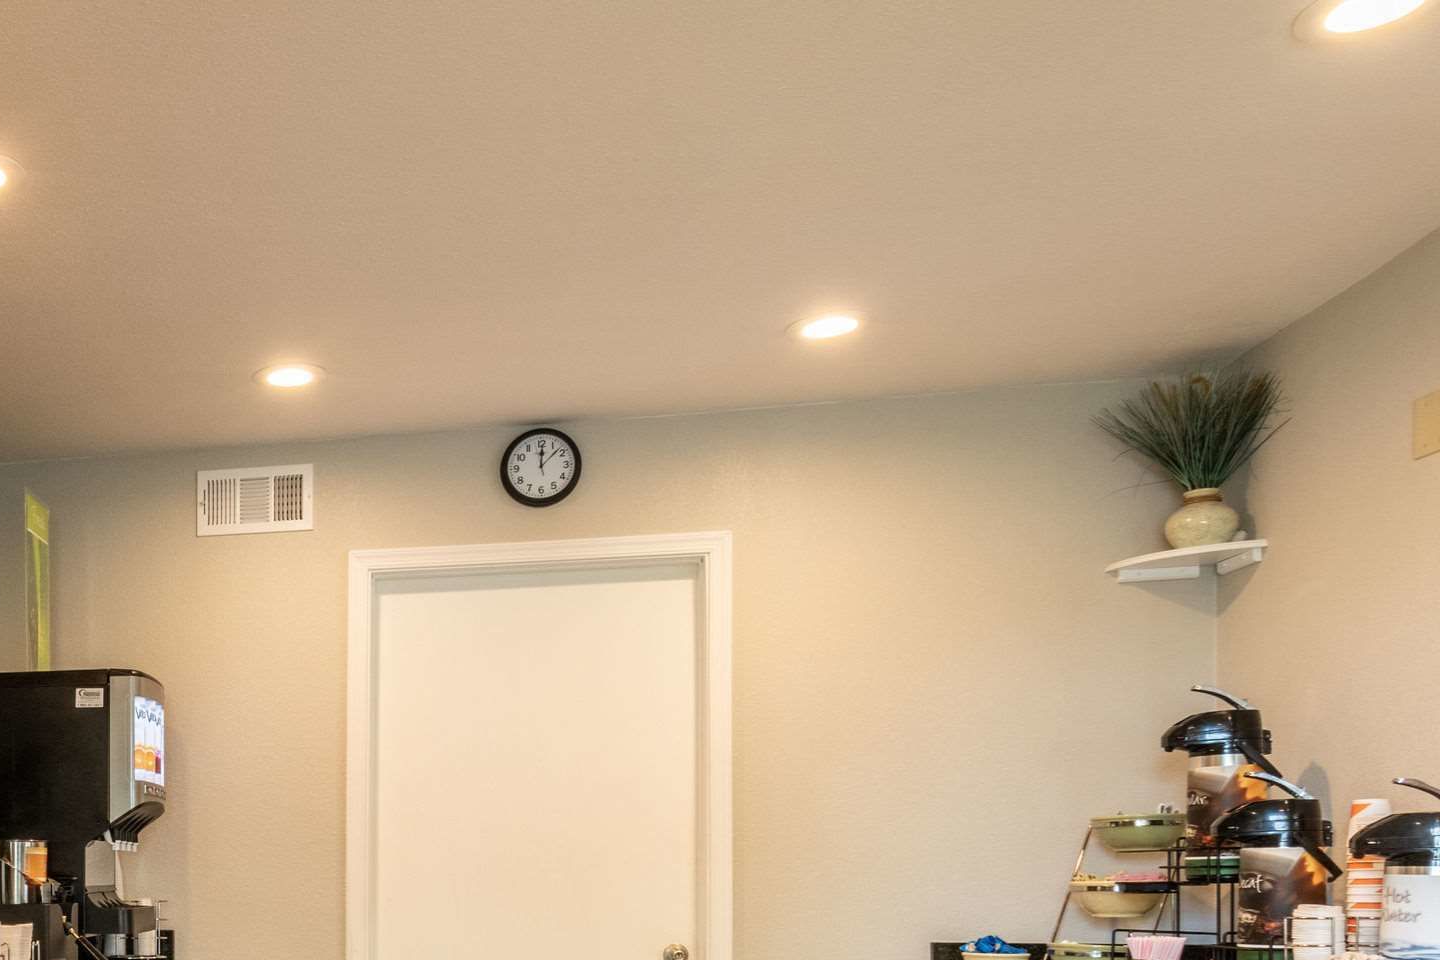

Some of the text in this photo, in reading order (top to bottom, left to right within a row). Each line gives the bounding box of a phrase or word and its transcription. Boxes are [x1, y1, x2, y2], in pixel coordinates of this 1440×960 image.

[526, 444, 531, 453] 11
[538, 440, 546, 449] 12
[516, 453, 526, 462] 10
[559, 449, 566, 457] 2
[513, 464, 520, 473] 9
[563, 461, 570, 469] 3
[517, 476, 524, 484] 8
[559, 472, 566, 480] 4
[526, 483, 533, 492] 7
[538, 486, 545, 494] 6
[550, 481, 557, 490] 5
